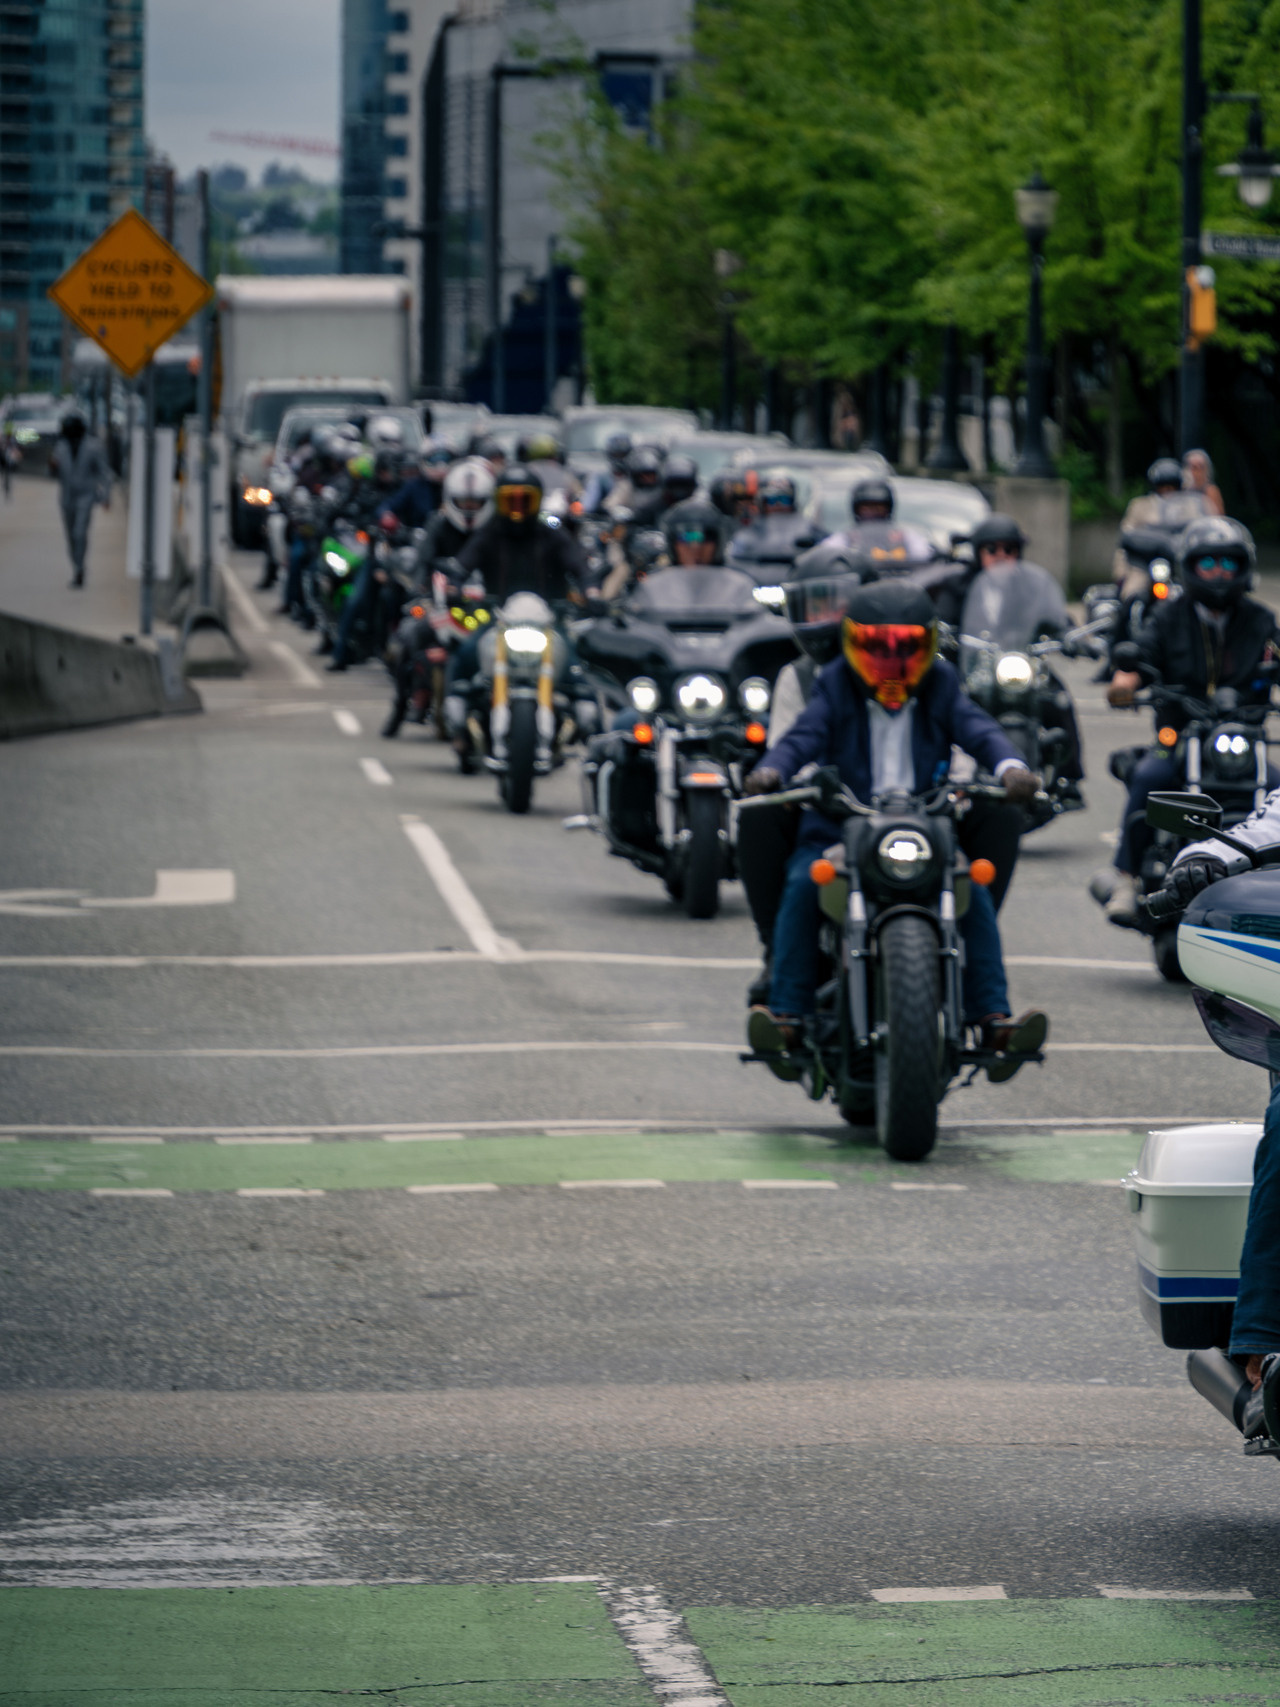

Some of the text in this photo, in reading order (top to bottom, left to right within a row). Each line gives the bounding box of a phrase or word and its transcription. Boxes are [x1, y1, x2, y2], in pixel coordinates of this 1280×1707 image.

[87, 259, 175, 276] CYCLISTS
[90, 281, 173, 298] YIELD TO
